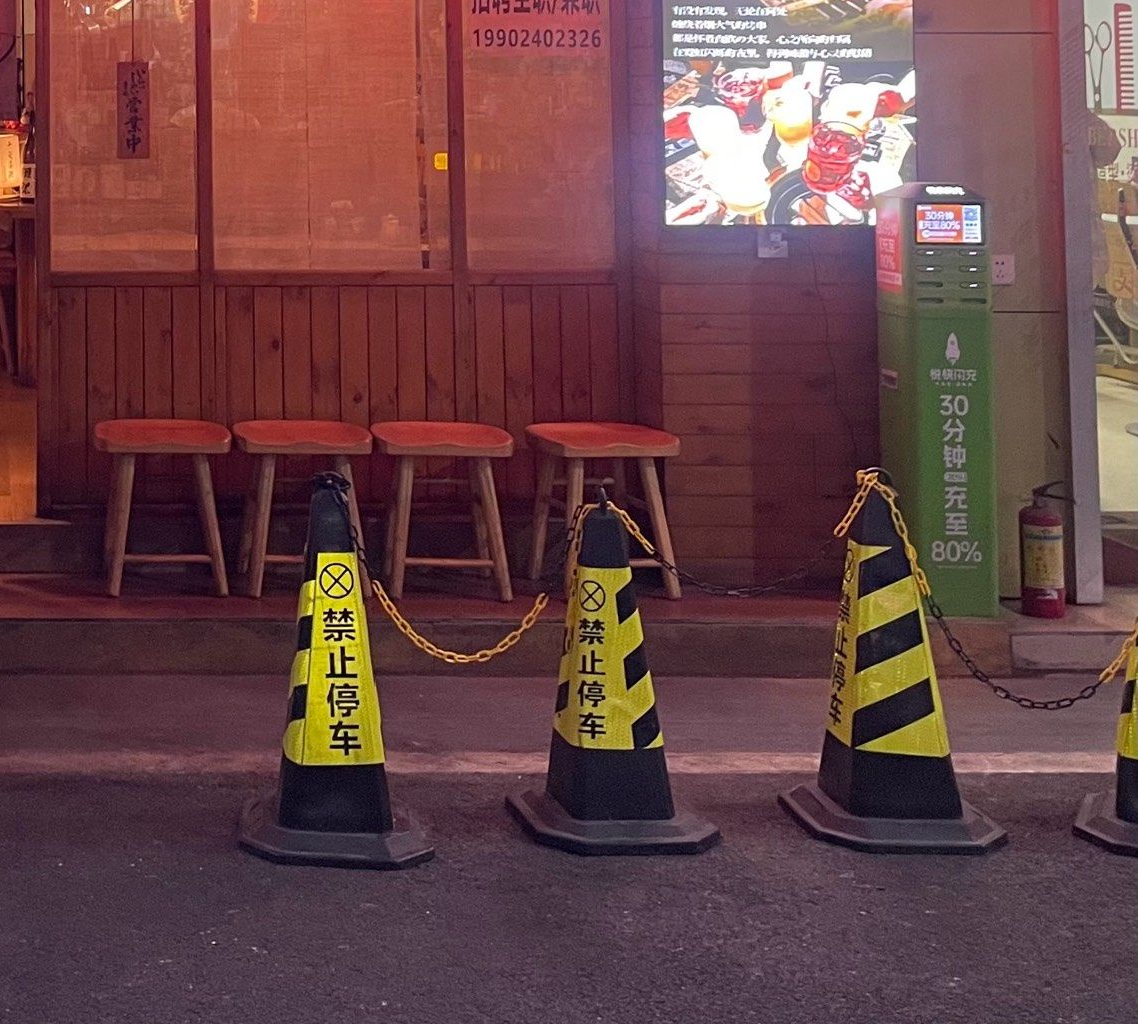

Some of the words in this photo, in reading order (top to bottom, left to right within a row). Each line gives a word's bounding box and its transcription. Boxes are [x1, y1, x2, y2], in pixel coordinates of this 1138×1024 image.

[473, 28, 601, 48] 19902402326
[323, 608, 361, 755] 禁止停车
[577, 618, 606, 739] 禁止停车
[828, 594, 851, 726] 禁止停车
